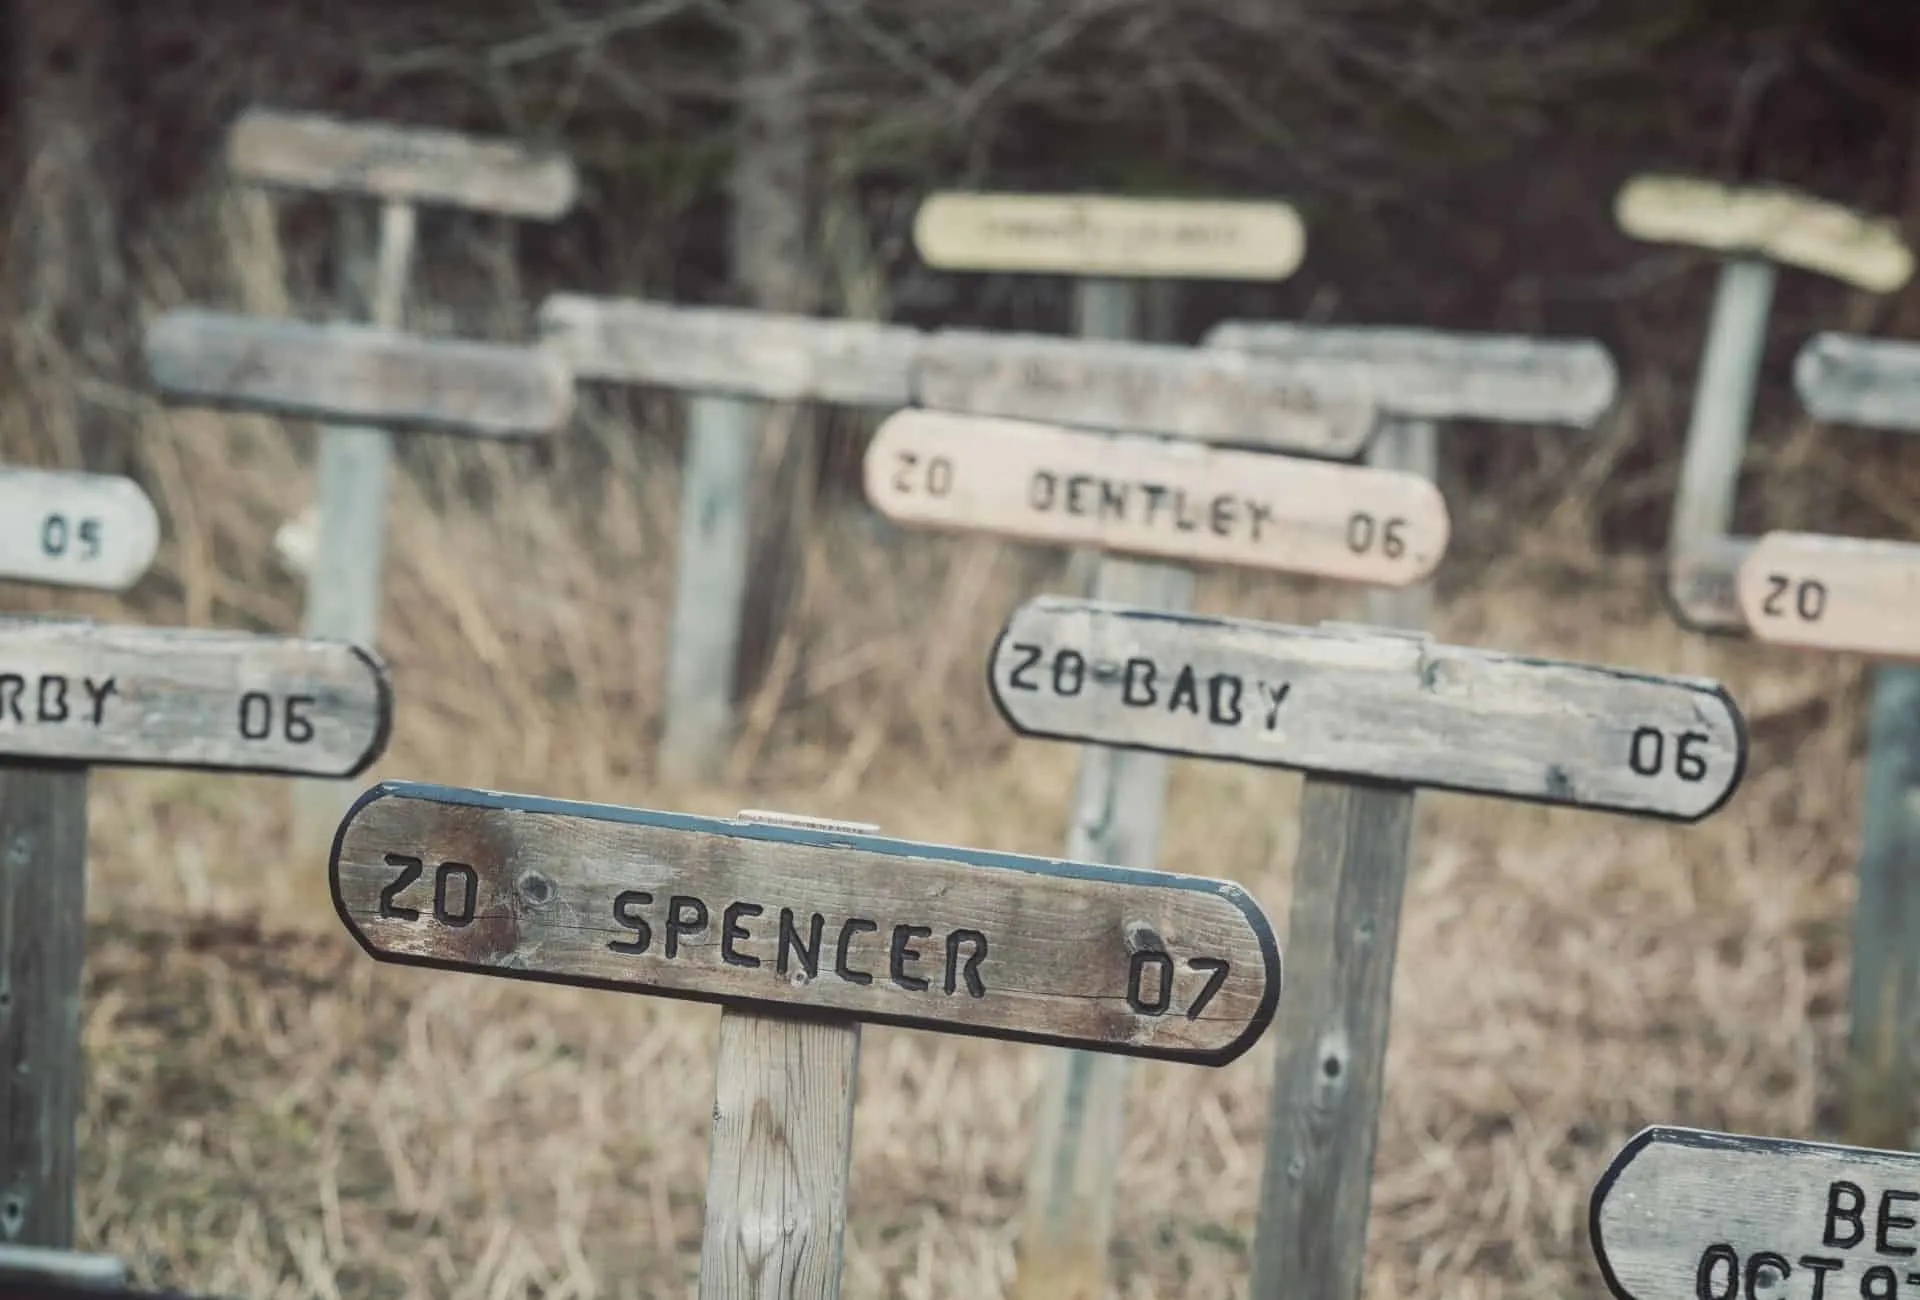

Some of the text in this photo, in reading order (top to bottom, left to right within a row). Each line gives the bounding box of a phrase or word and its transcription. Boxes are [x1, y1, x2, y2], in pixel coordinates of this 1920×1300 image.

[894, 451, 952, 498] 20
[1345, 513, 1408, 559] 06
[1764, 573, 1825, 622] 20
[238, 691, 314, 744] 06
[1010, 643, 1709, 782] 20 BABY 06
[379, 853, 1231, 1022] 20 SPENCER 07
